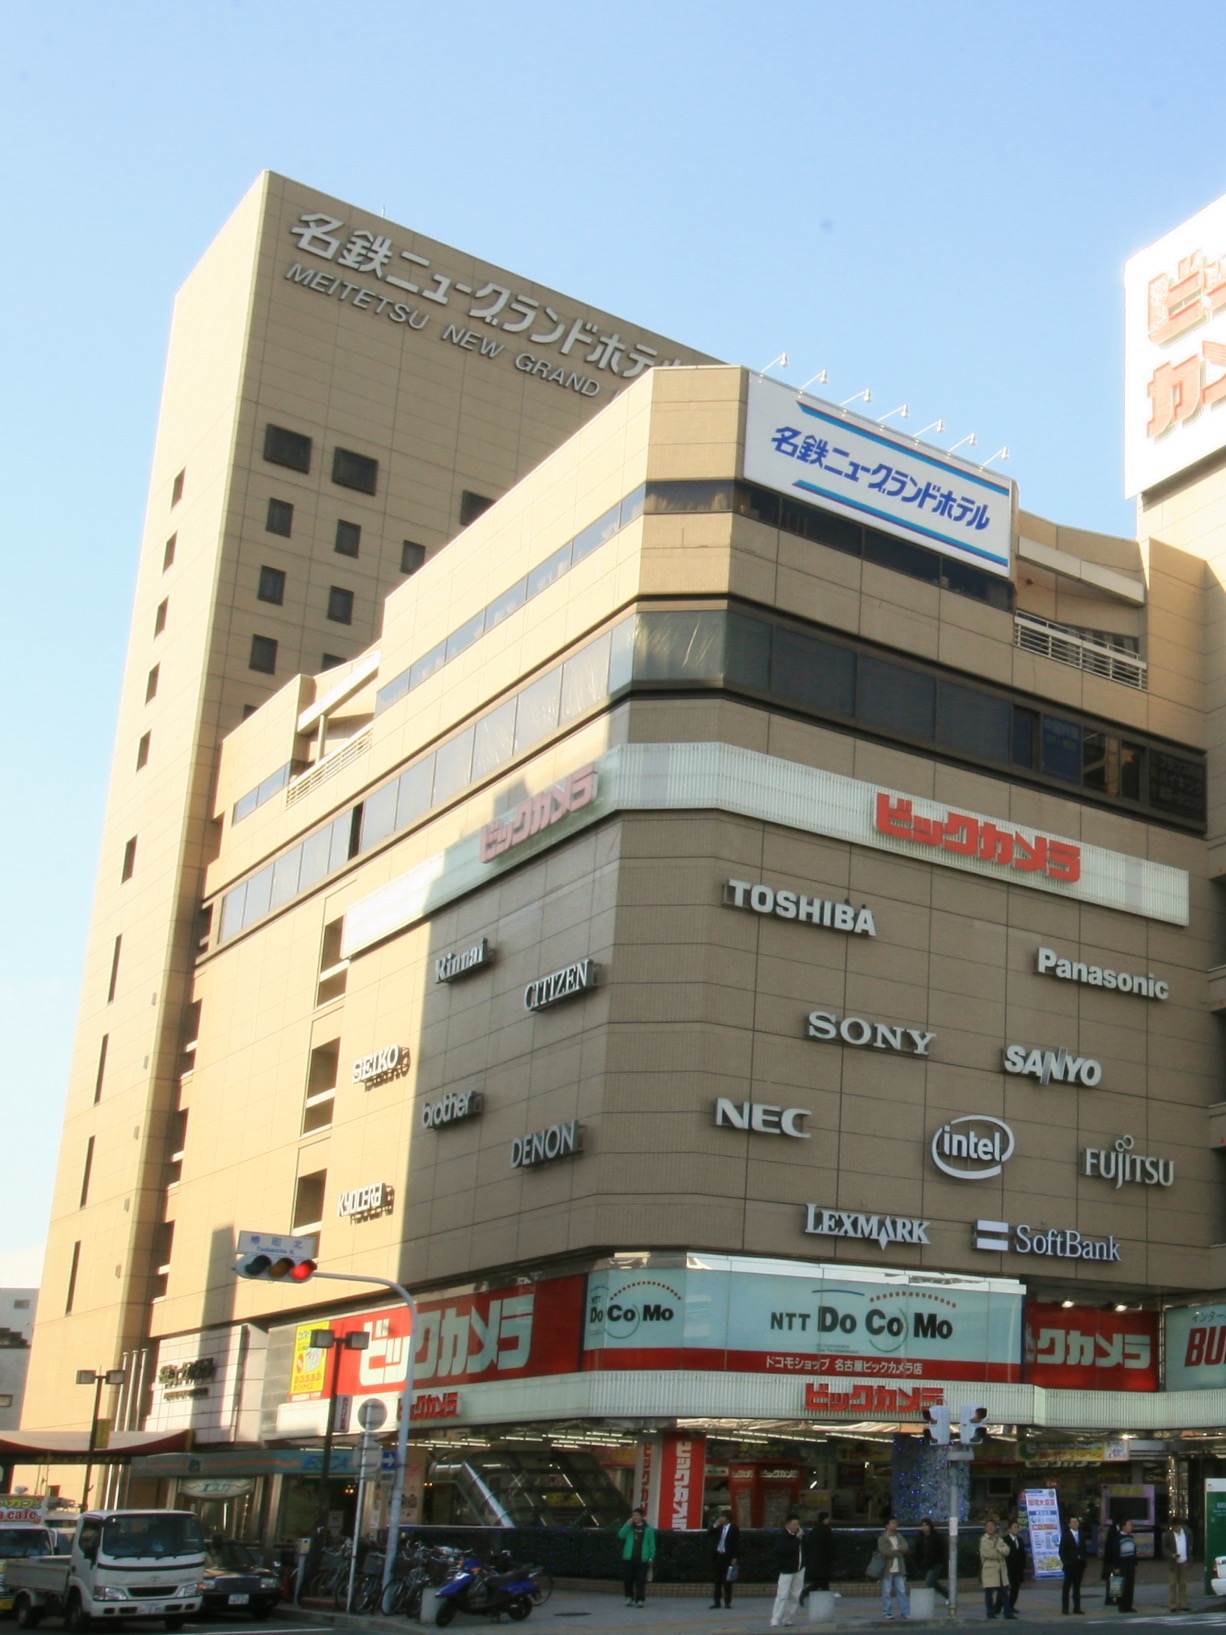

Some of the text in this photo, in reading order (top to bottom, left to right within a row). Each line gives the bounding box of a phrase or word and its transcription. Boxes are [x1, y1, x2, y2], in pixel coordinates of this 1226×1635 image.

[290, 213, 682, 378] 名鉄ニューグランドホテ
[284, 263, 600, 398] MEITETSU NEW GRAND
[771, 426, 990, 530] 名鉄ニューグランドホテル
[480, 761, 598, 864] ビックカメラ
[876, 792, 1081, 883] ビックカメラ
[728, 878, 877, 937] TOSHIBA
[434, 936, 490, 985] Rinnai
[1036, 946, 1170, 1001] Panasonic
[523, 958, 596, 1012] CITIZEN
[808, 1010, 937, 1056] SONY
[352, 1042, 401, 1084] SEIKO
[1003, 1044, 1103, 1088] SANYO
[420, 1090, 476, 1130] brother
[714, 1097, 813, 1139] NEC
[510, 1119, 580, 1169] DENON
[943, 1124, 1002, 1163] intel
[1084, 1135, 1176, 1189] FUJITSU
[336, 1181, 387, 1218] KYOCERA
[804, 1203, 932, 1251] LEXMARK
[1015, 1223, 1122, 1263] SoftBank
[590, 1304, 674, 1324] Do Co Mo
[770, 1306, 953, 1339] NTT Do Co Mo
[360, 1293, 535, 1387] ビックカメラ
[766, 1355, 923, 1375] ドコモショップ 名古屋ビックカメラ店
[805, 1382, 945, 1413] ビックカメラ
